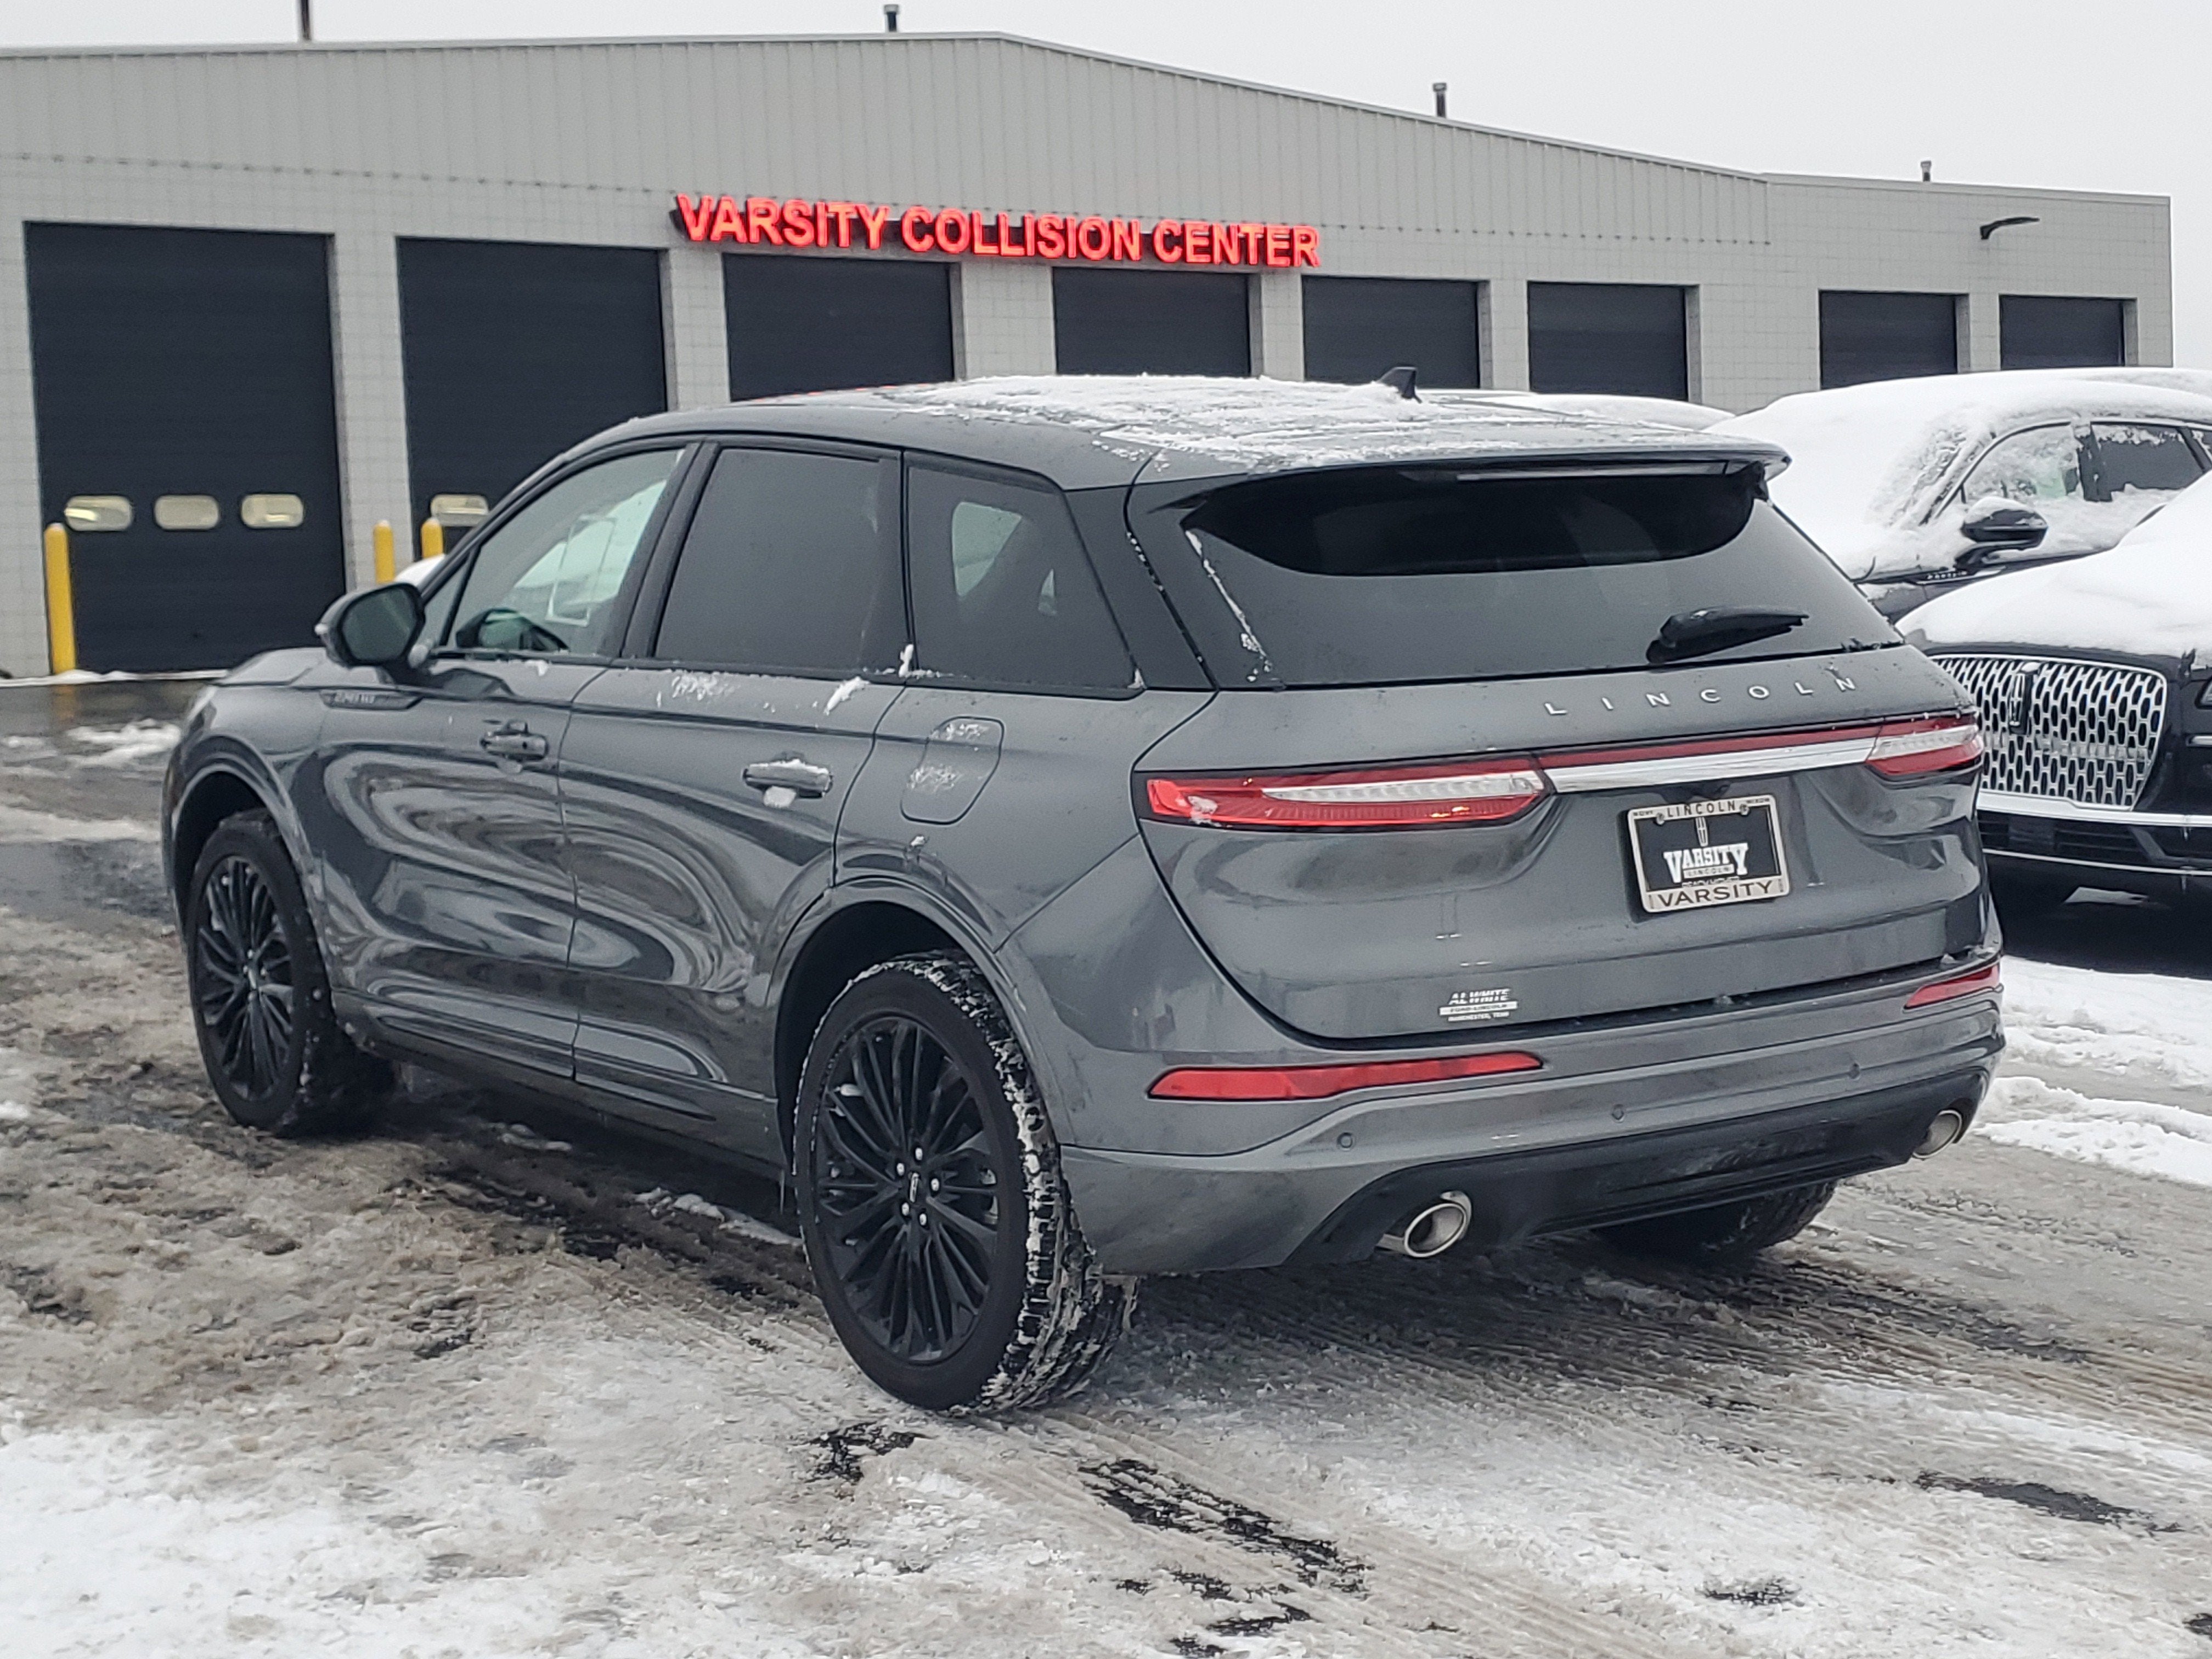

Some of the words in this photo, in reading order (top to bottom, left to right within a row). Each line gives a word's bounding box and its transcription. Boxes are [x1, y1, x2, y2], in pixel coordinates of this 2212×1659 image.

[676, 194, 890, 250] VARSITY
[900, 207, 1141, 261] COLLISION
[1151, 219, 1321, 268] CENTER
[1545, 676, 1856, 715] LINCOLN
[1667, 800, 1736, 818] LINCOLN
[1663, 843, 1748, 883] VARSITY
[1657, 880, 1773, 907] VARSITY
